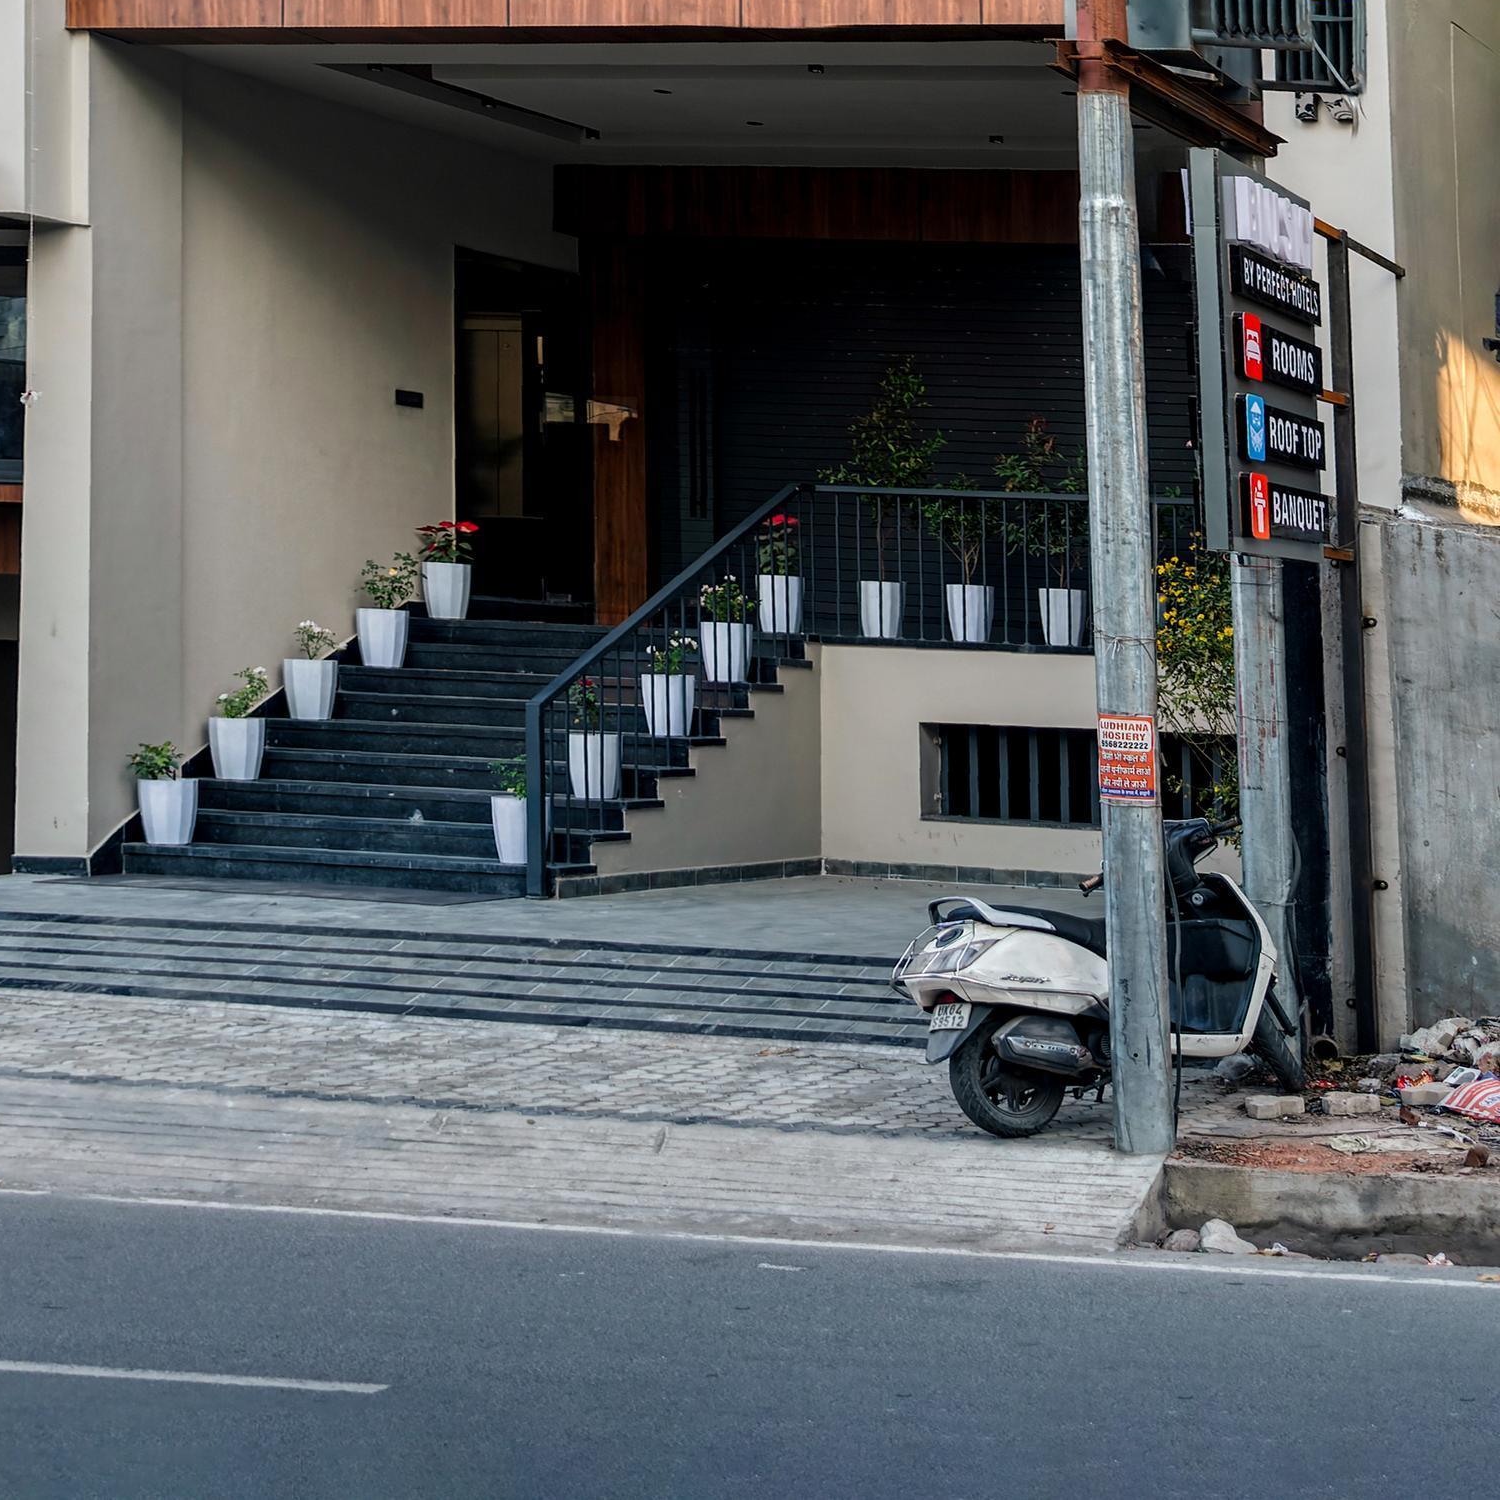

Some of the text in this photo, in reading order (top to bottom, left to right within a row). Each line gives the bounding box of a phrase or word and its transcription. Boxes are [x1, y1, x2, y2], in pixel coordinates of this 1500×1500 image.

[1243, 256, 1319, 317] BY PERFECT HOTELS
[1272, 337, 1315, 385] ROOMS
[1269, 415, 1322, 461] ROOF TOP
[1273, 490, 1326, 532] BANQUET
[1100, 721, 1149, 732] LUDHIANA
[1102, 730, 1146, 741] HOSIERY
